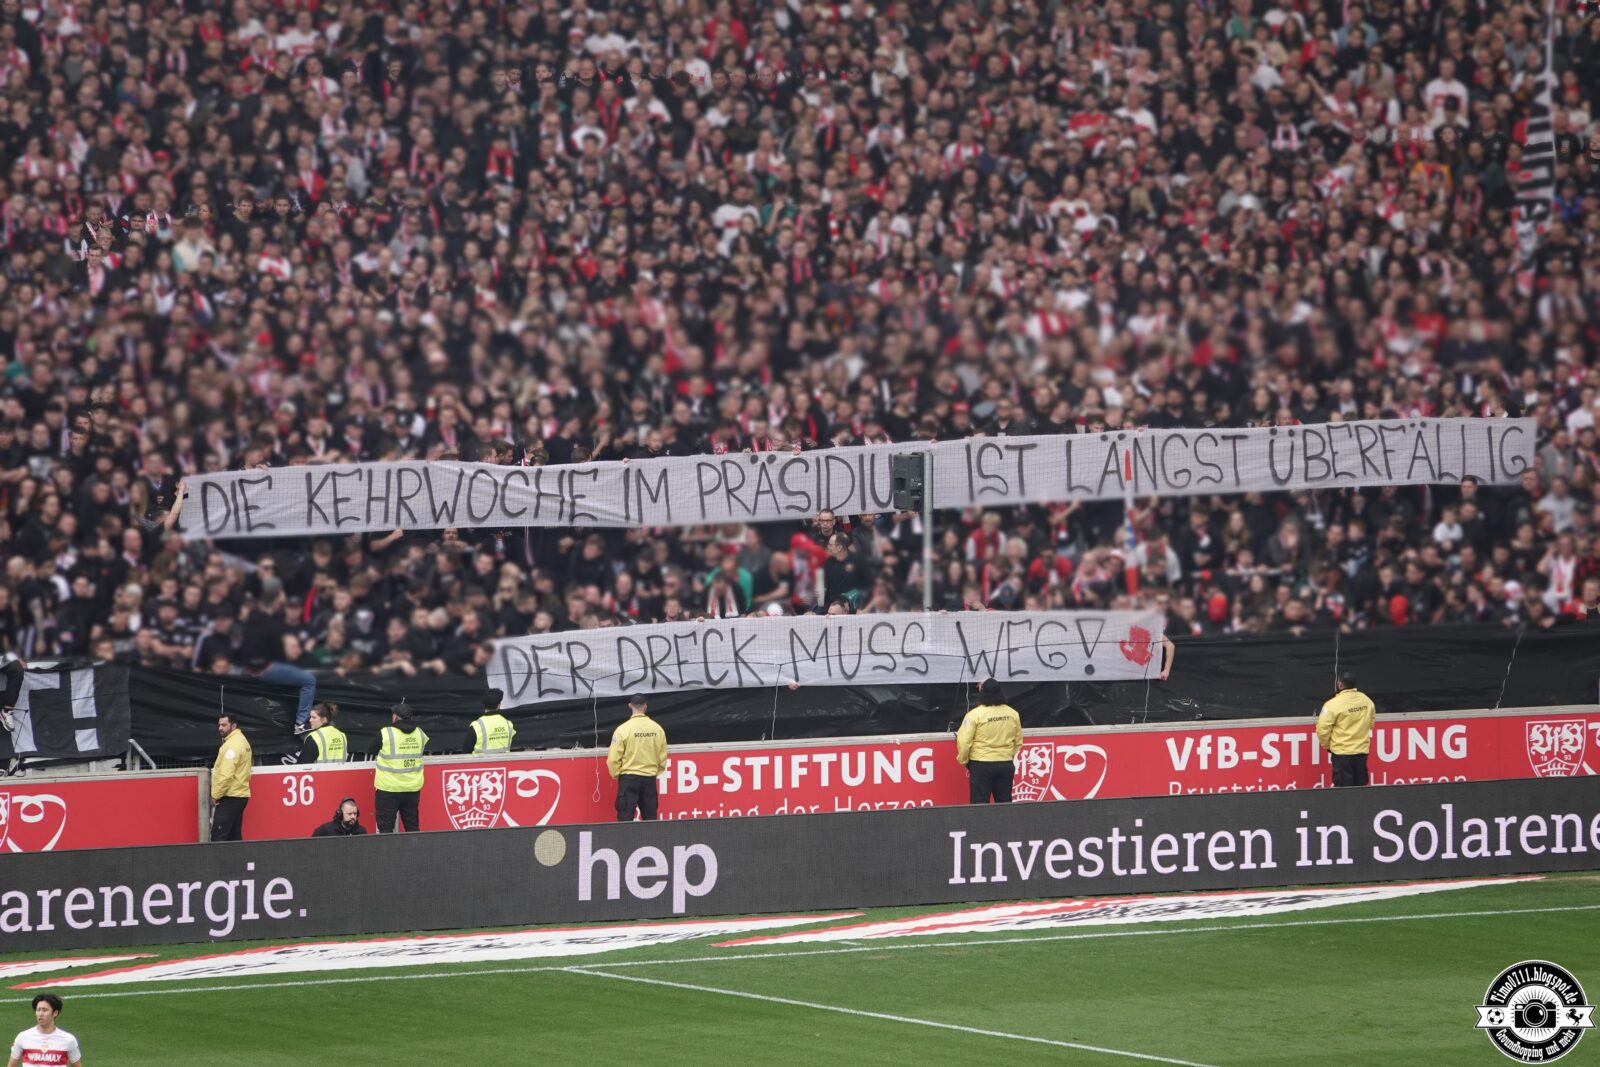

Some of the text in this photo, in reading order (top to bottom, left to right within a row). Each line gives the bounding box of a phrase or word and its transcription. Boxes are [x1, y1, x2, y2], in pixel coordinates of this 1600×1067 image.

[201, 421, 1528, 535] DIE KEHRWOCHE IM PRÄSIDIU IST LÄNGST ÜBERFÄLLIG
[501, 617, 1105, 700] DER DRECK MUSS WEG!
[657, 747, 934, 795] fB-STIFTUNG
[1165, 724, 1467, 771] VfB-STIUNG
[282, 774, 315, 807] 36
[578, 831, 718, 914] hep
[948, 818, 1277, 885] Investieren
[1296, 810, 1354, 867] in
[0, 862, 307, 938] arenergie.
